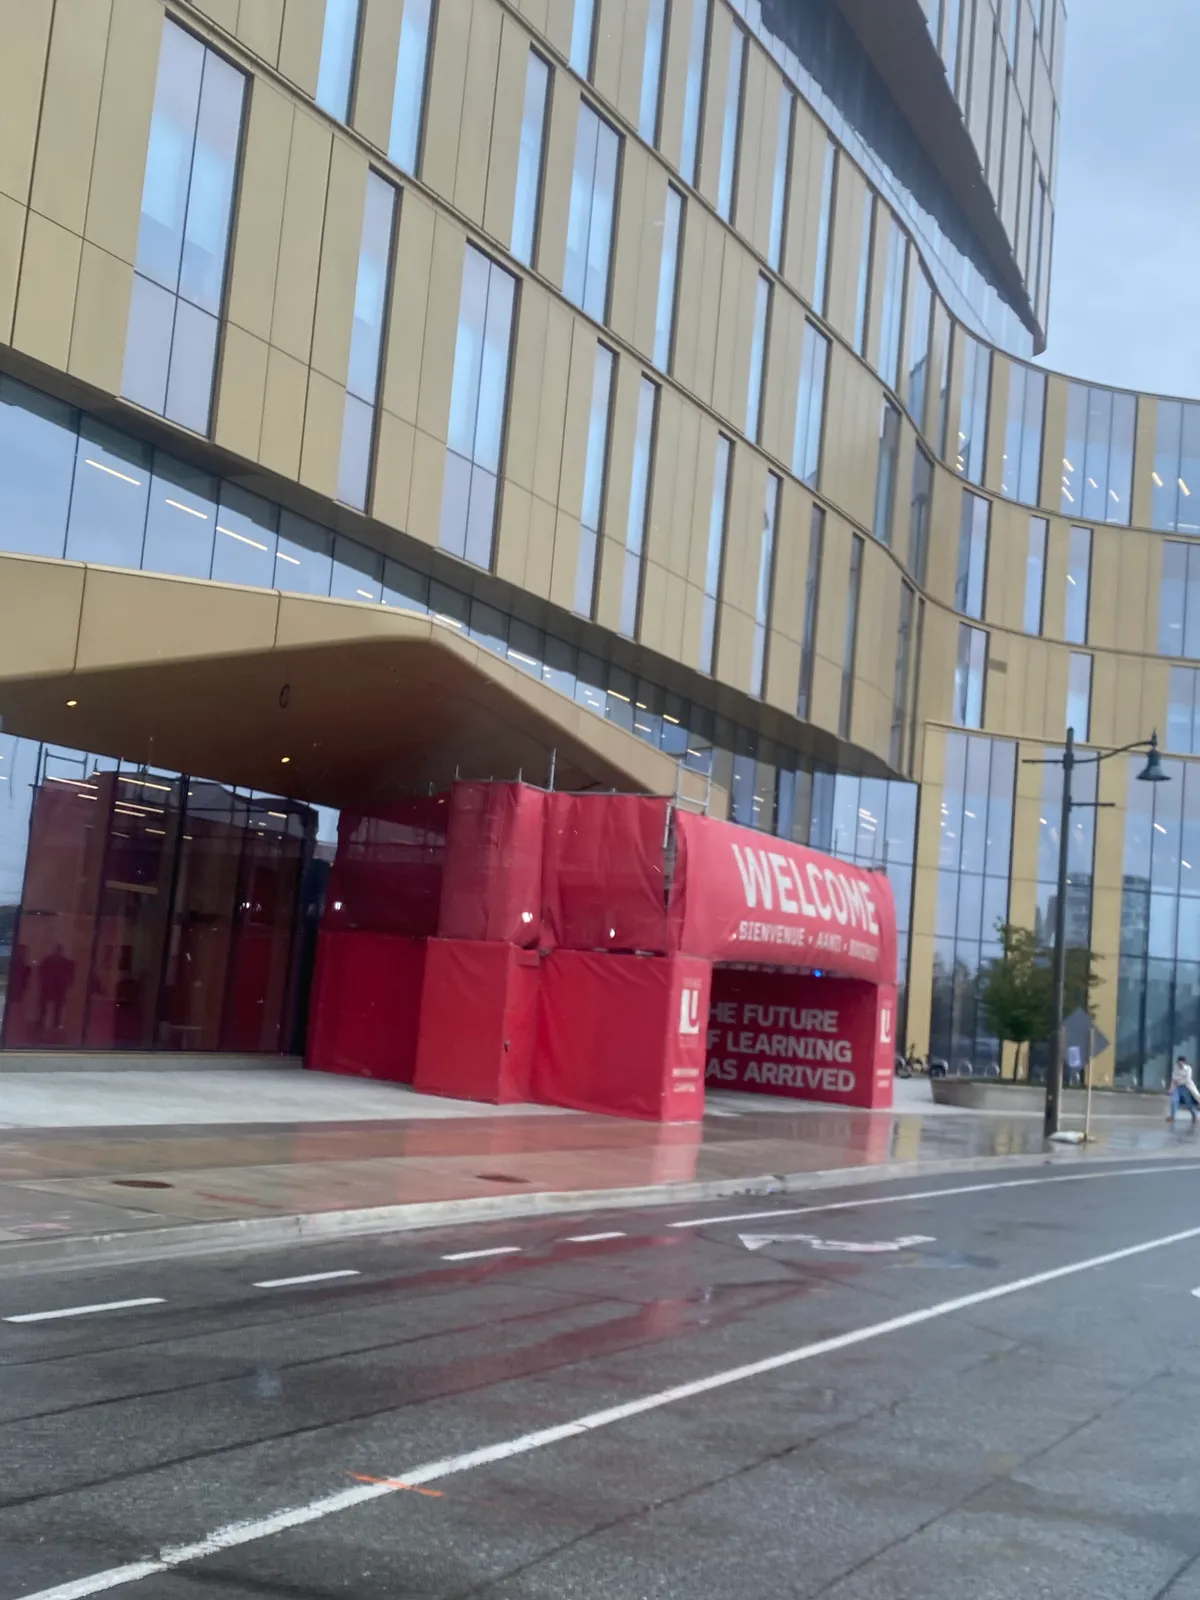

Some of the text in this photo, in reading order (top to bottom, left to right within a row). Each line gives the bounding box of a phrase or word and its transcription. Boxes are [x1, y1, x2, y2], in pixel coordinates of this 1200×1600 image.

[732, 844, 879, 935] WELCOME
[739, 920, 806, 946] BIENVENUE
[709, 1002, 838, 1032] HE FUTURE
[706, 1029, 721, 1050] F
[726, 1031, 853, 1064] LEARNING
[705, 1057, 856, 1093] AS ARRIVED
